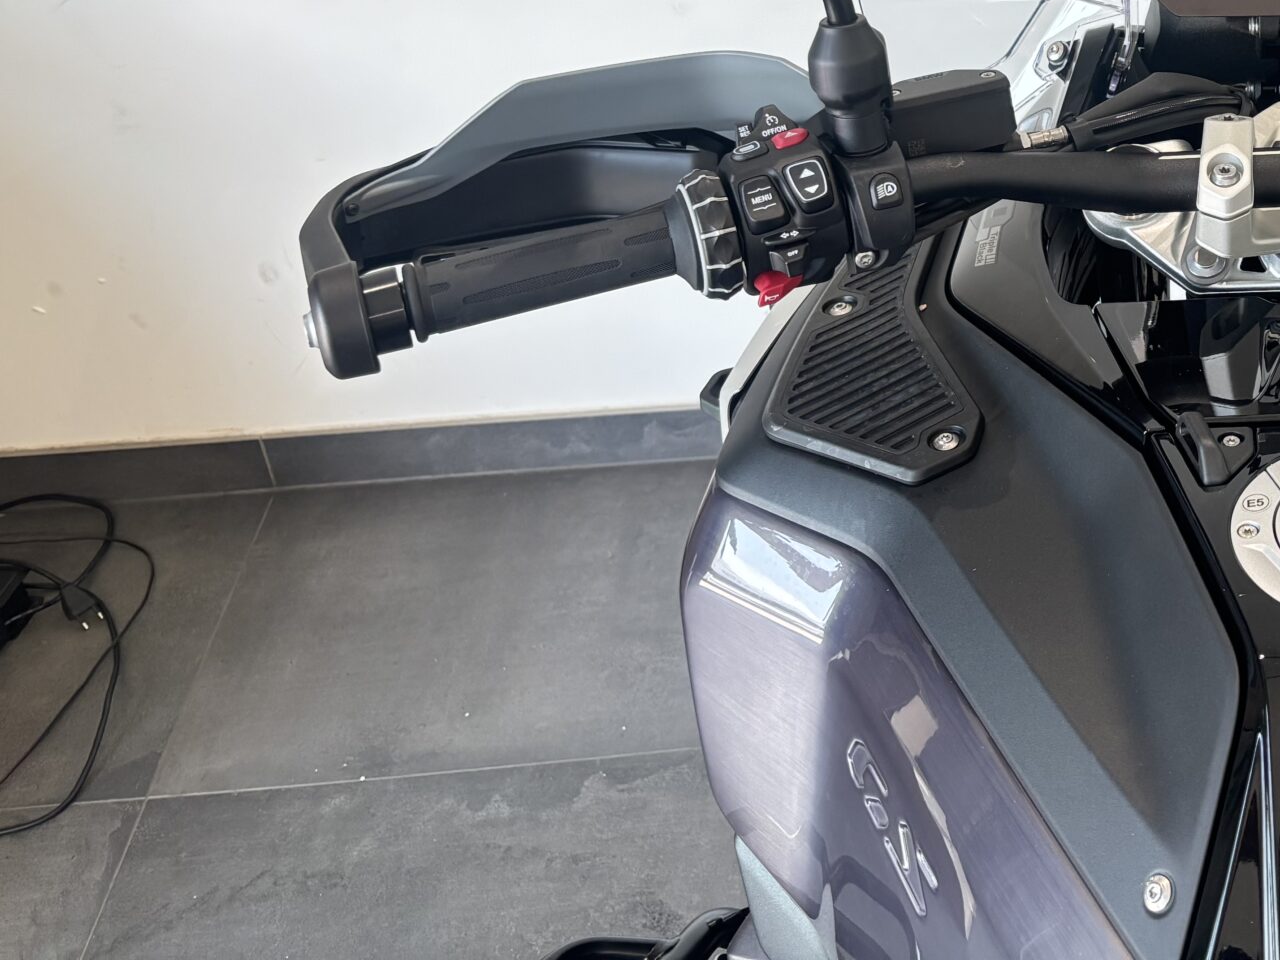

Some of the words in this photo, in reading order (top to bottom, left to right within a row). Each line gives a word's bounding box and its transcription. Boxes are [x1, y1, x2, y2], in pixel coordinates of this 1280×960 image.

[738, 125, 749, 133] SET
[761, 124, 787, 138] OFF/ON
[751, 192, 773, 206] MENU
[986, 231, 998, 254] Triple
[787, 249, 799, 257] OFF
[1246, 497, 1265, 508] E5
